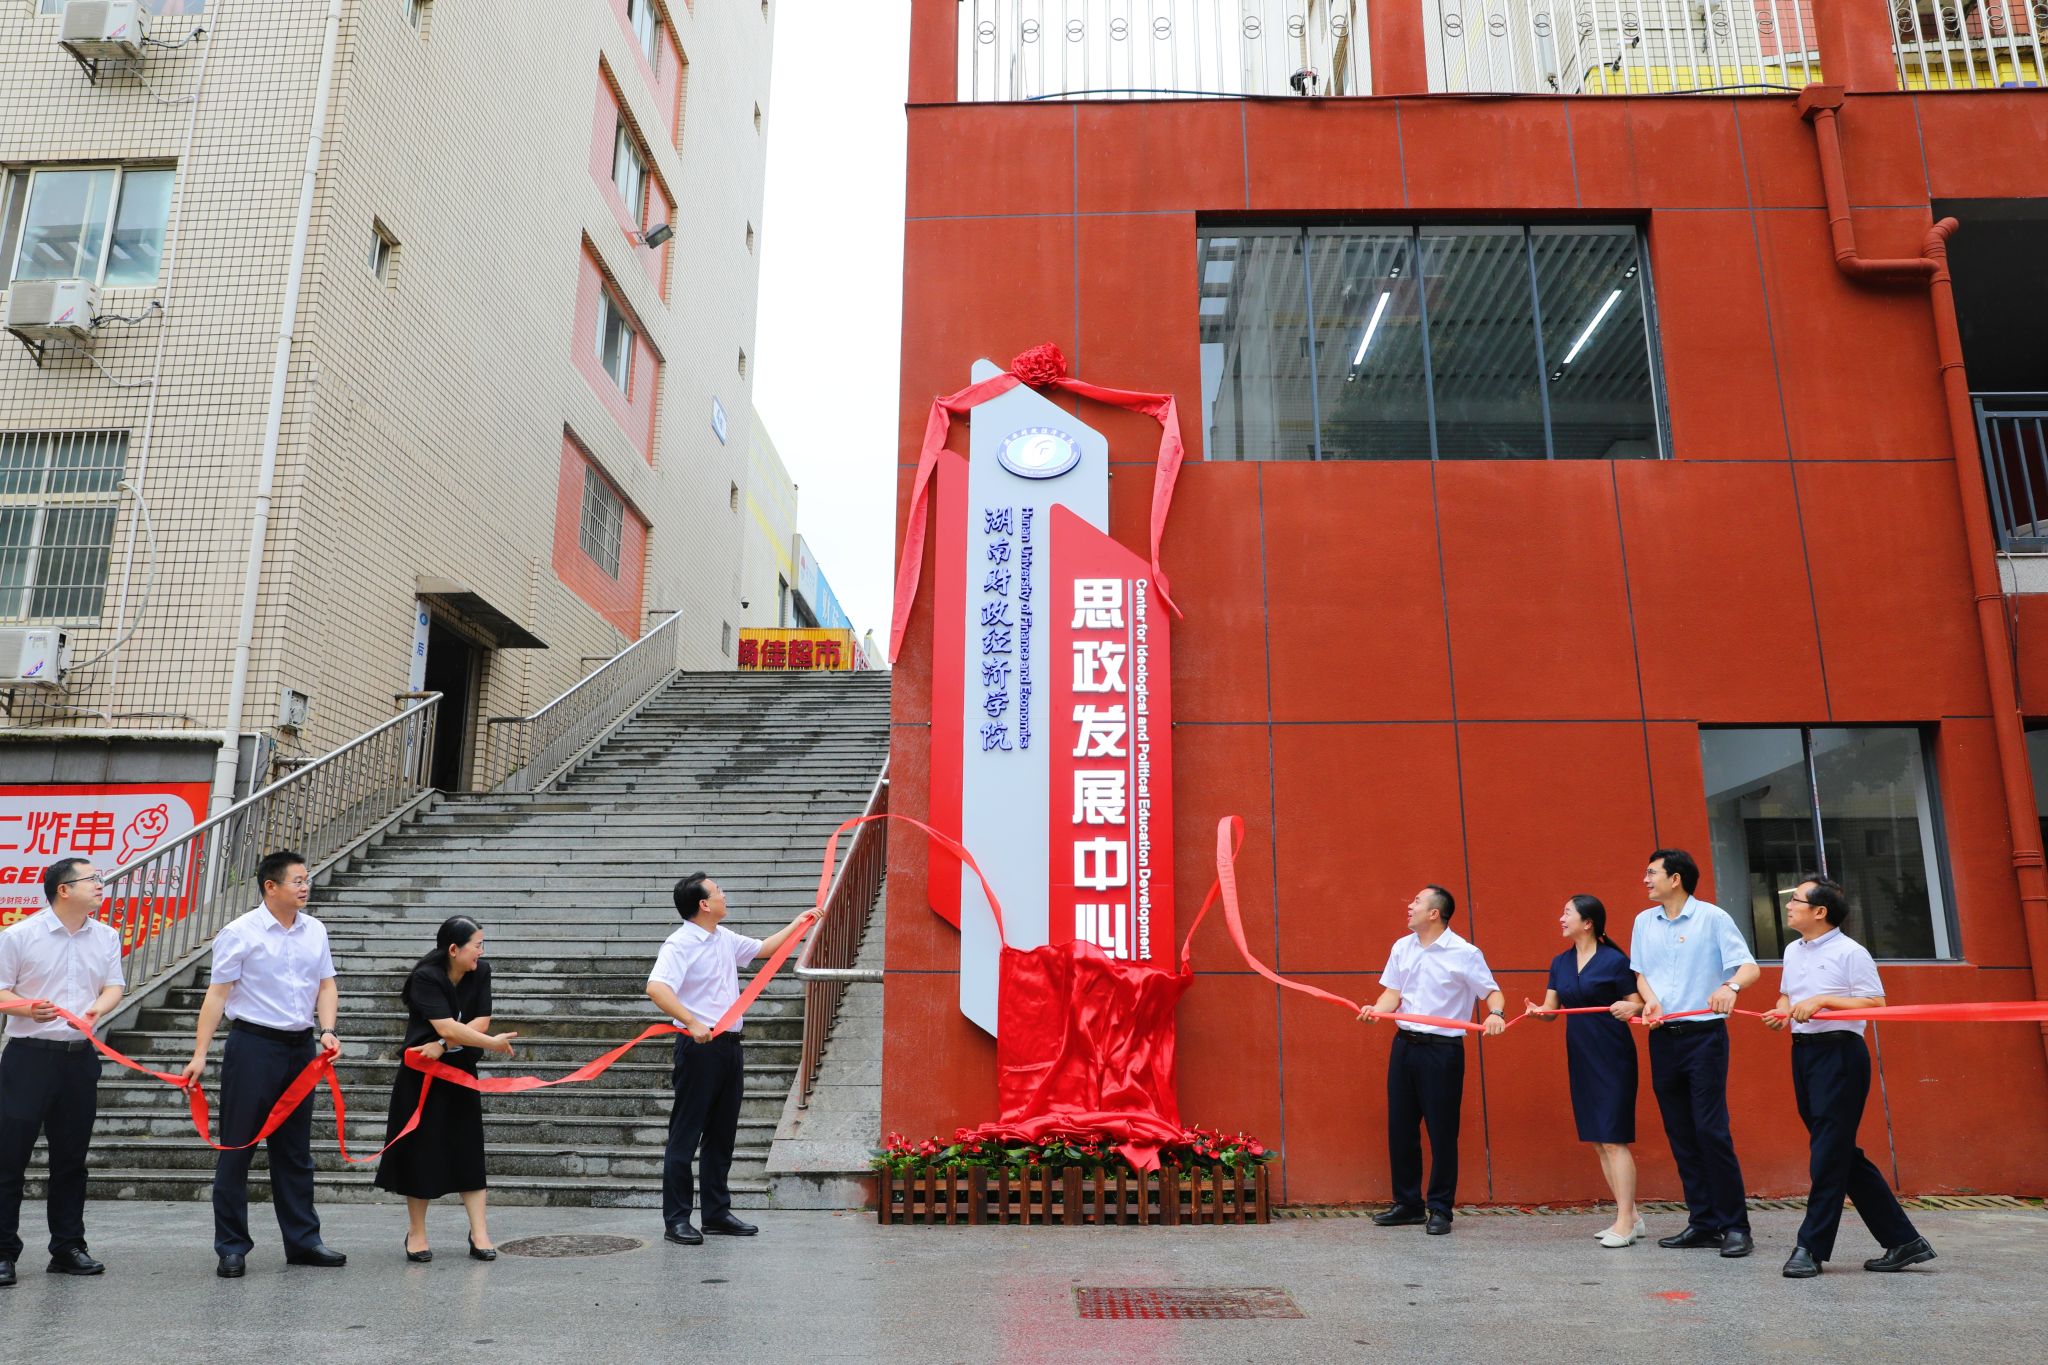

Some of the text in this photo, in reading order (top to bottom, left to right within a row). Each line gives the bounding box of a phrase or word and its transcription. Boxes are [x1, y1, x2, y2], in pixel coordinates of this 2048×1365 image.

[980, 505, 1013, 751] 湖南财政经济学院
[1019, 507, 1033, 749] Hunan University of Finance and Economics
[1071, 578, 1128, 960] 思政发展中心
[1135, 579, 1151, 960] Center for Ideological and Political Education Development
